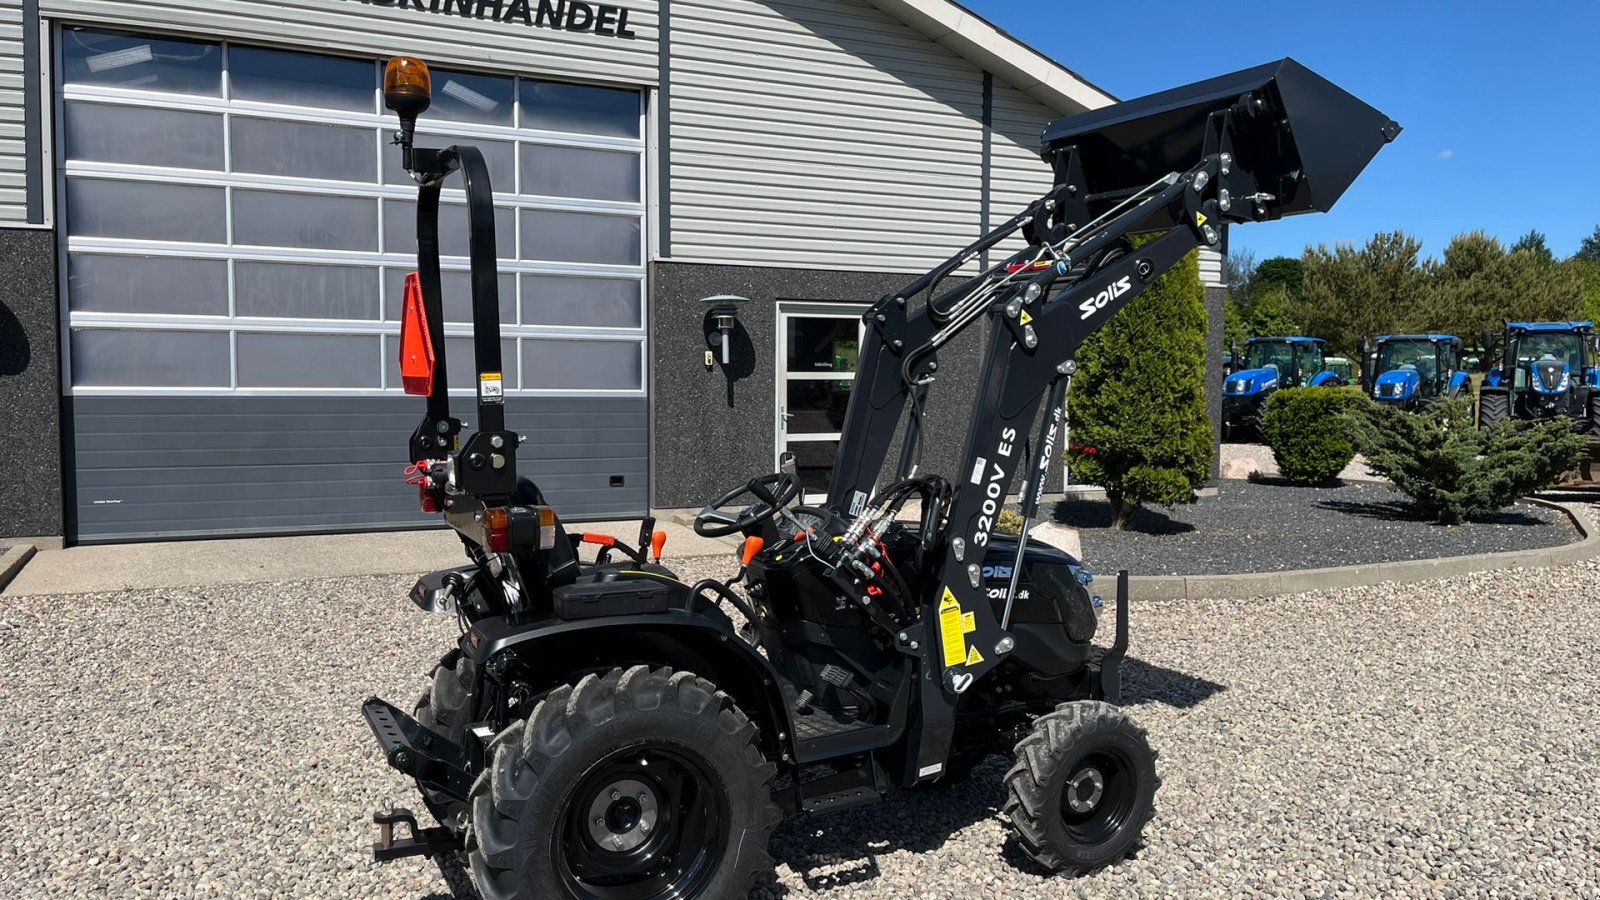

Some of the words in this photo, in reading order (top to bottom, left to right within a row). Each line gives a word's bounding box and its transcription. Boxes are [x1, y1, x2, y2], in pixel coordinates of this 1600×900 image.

[344, 0, 635, 39] NHANDEL
[974, 463, 1005, 547] 3200V
[998, 427, 1016, 457] ES
